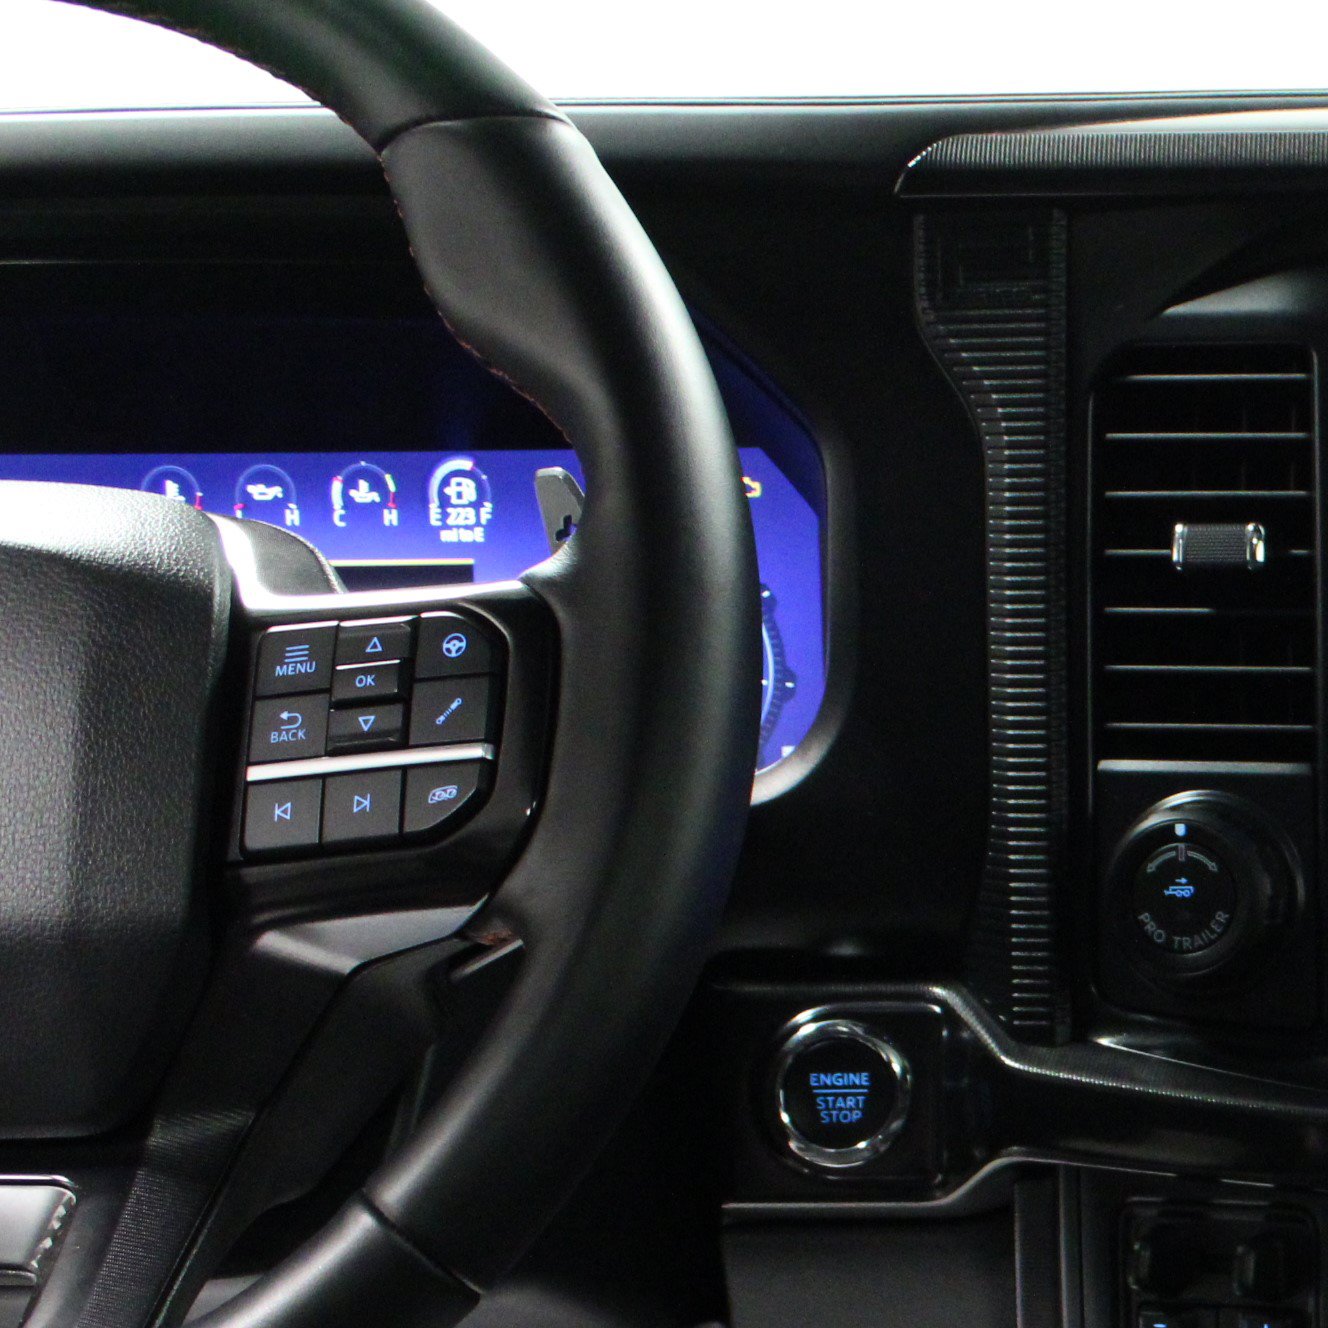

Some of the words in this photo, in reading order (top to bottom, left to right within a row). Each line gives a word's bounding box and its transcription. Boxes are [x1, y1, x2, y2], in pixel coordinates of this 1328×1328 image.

[275, 661, 316, 677] MENU
[355, 674, 375, 687] OK
[270, 729, 306, 744] BACK
[1138, 912, 1166, 943] PRO
[1173, 910, 1230, 950] TRAILER
[809, 1073, 869, 1086] ENGINE
[816, 1096, 866, 1110] START
[820, 1110, 863, 1124] STOP
